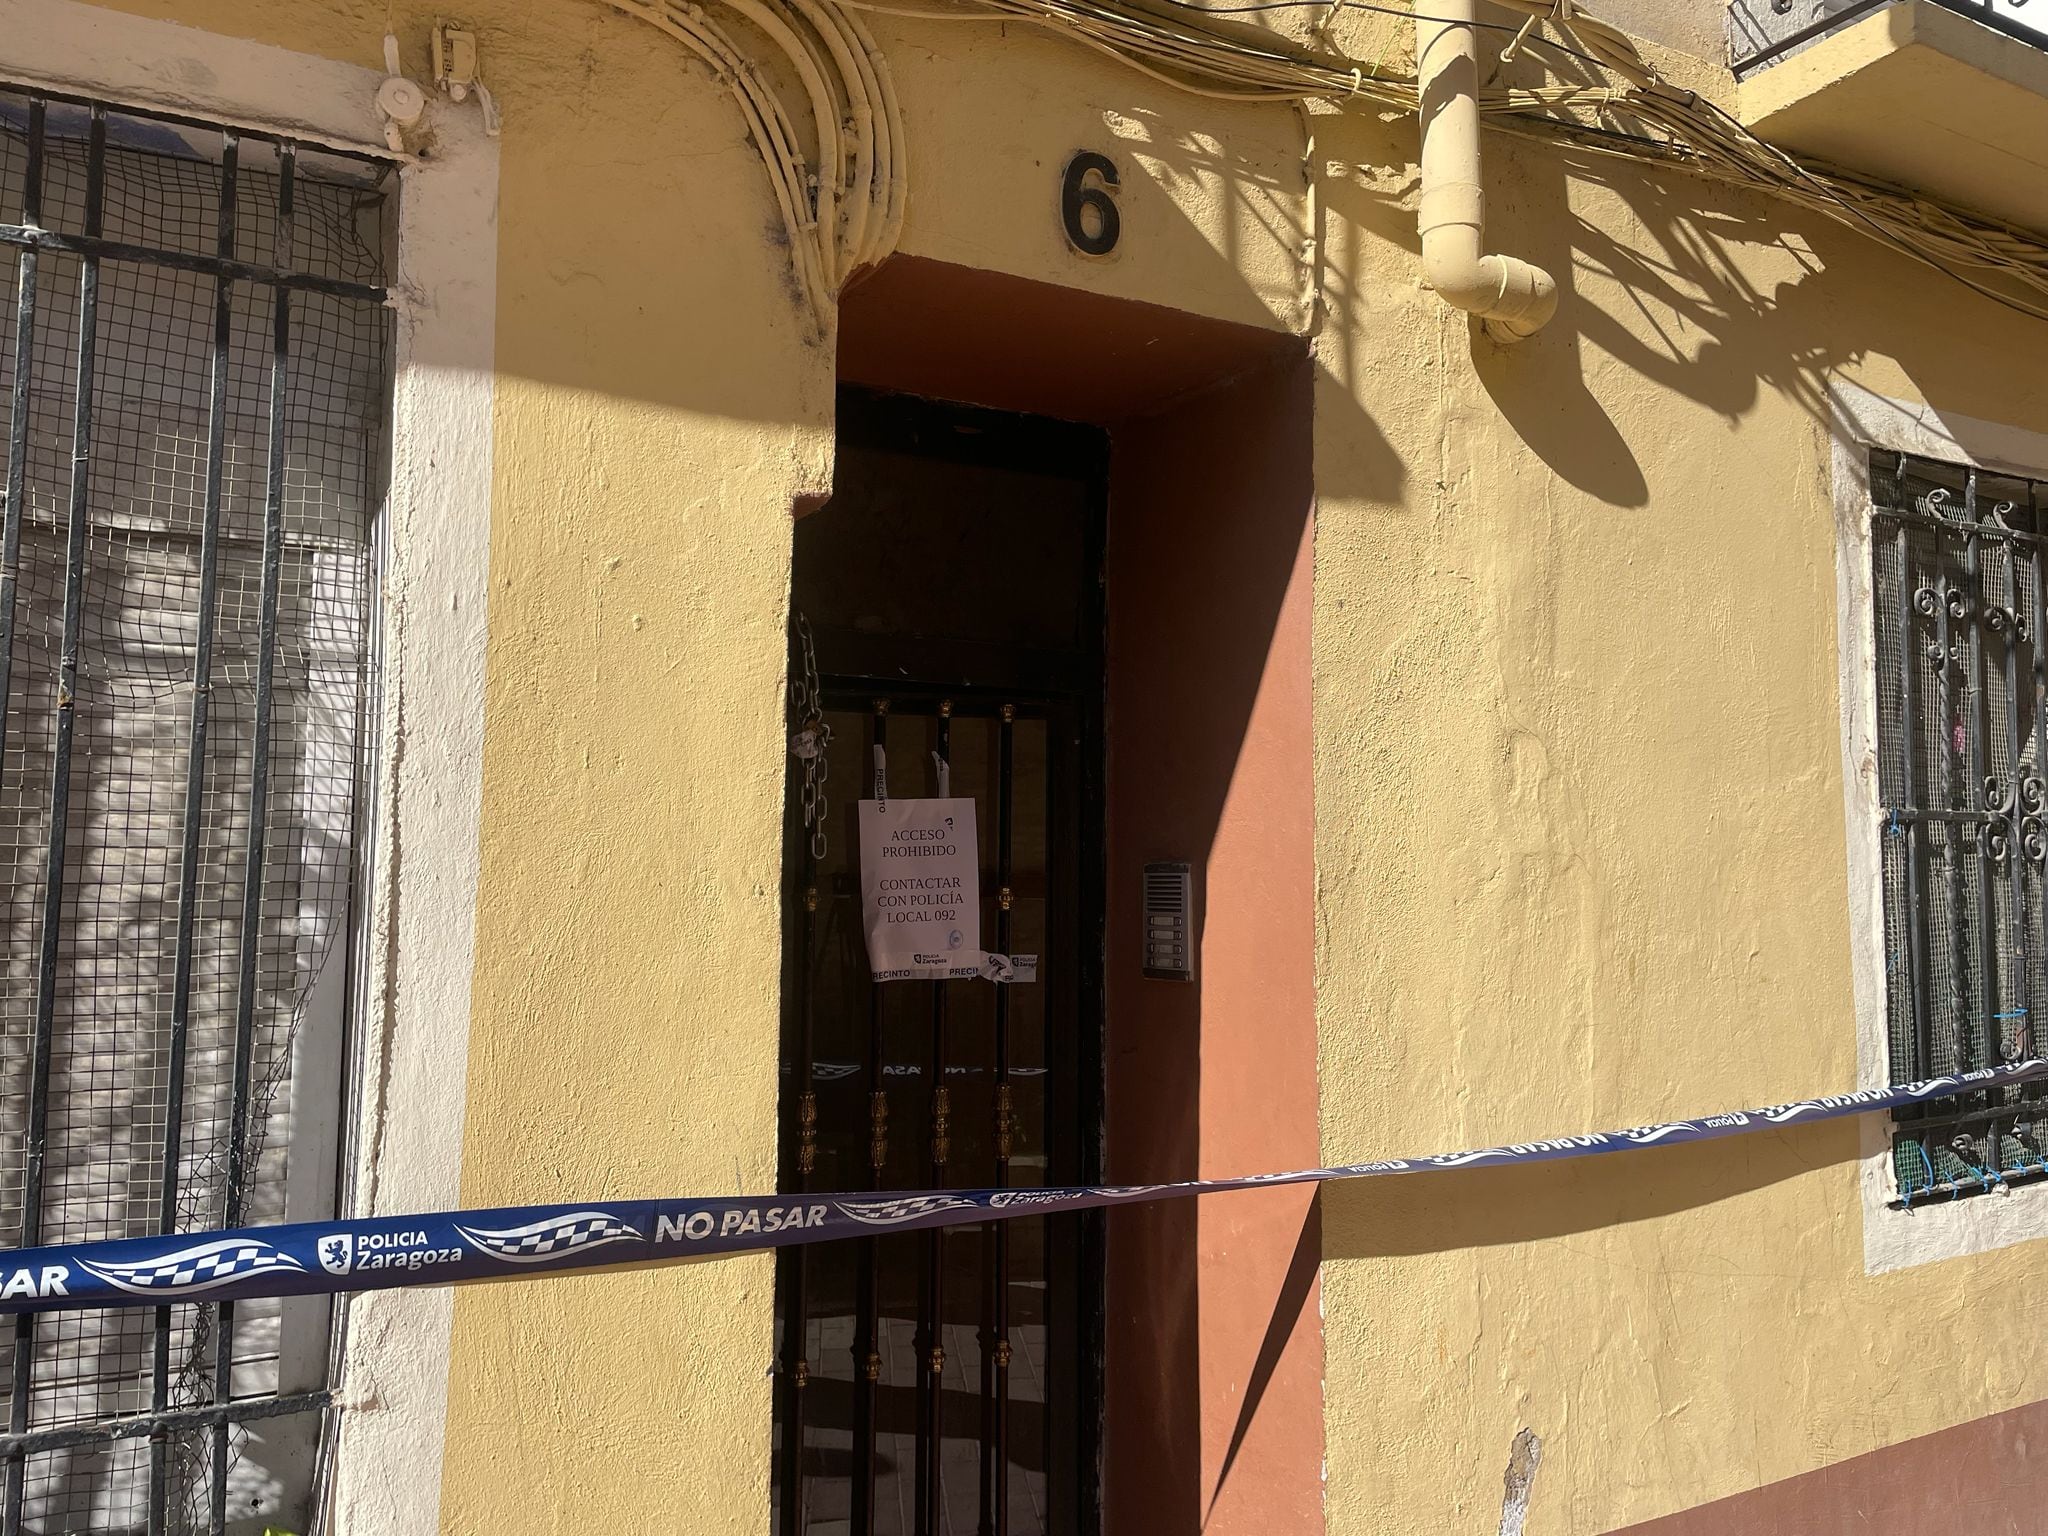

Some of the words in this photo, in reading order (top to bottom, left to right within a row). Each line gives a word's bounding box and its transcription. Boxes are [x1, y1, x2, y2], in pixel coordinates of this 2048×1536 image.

[1062, 151, 1120, 256] 6
[891, 829, 945, 841] ACCESO
[882, 845, 956, 857] PROHIBIDO
[879, 877, 961, 891] CONTACTAR
[877, 895, 907, 908] CON
[910, 891, 964, 906] POLICÍA
[887, 911, 931, 923] LOCAL
[934, 909, 956, 921] 092
[655, 1212, 715, 1243] NO
[720, 1204, 828, 1237] PASAR
[358, 1230, 429, 1251] POLICIA
[356, 1247, 463, 1271] Zaragoza
[0, 1265, 70, 1300] AR
